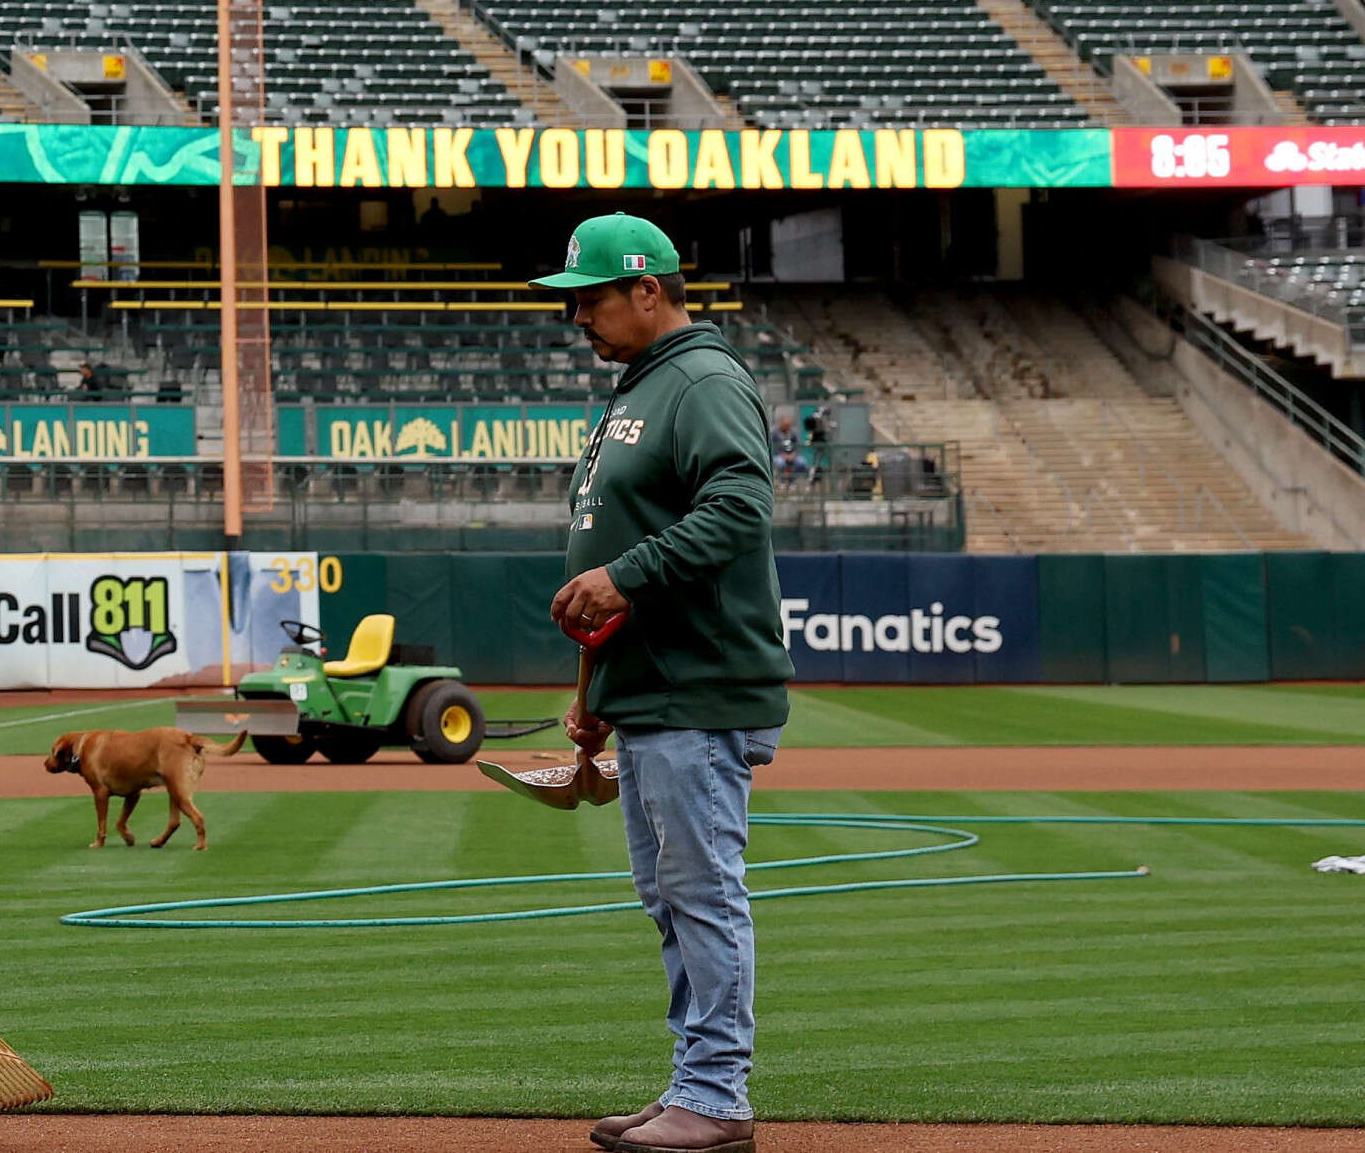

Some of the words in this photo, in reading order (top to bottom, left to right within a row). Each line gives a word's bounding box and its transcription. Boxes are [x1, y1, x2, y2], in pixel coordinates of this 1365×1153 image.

[251, 127, 475, 187] THANK
[495, 128, 625, 188] YOU
[647, 129, 965, 189] OAKLAND
[13, 419, 149, 458] LANDING
[331, 419, 391, 458] OAK
[451, 419, 588, 458] LANDING
[270, 557, 343, 594] 330
[91, 575, 170, 636] 811
[780, 598, 1003, 653] Fanatics
